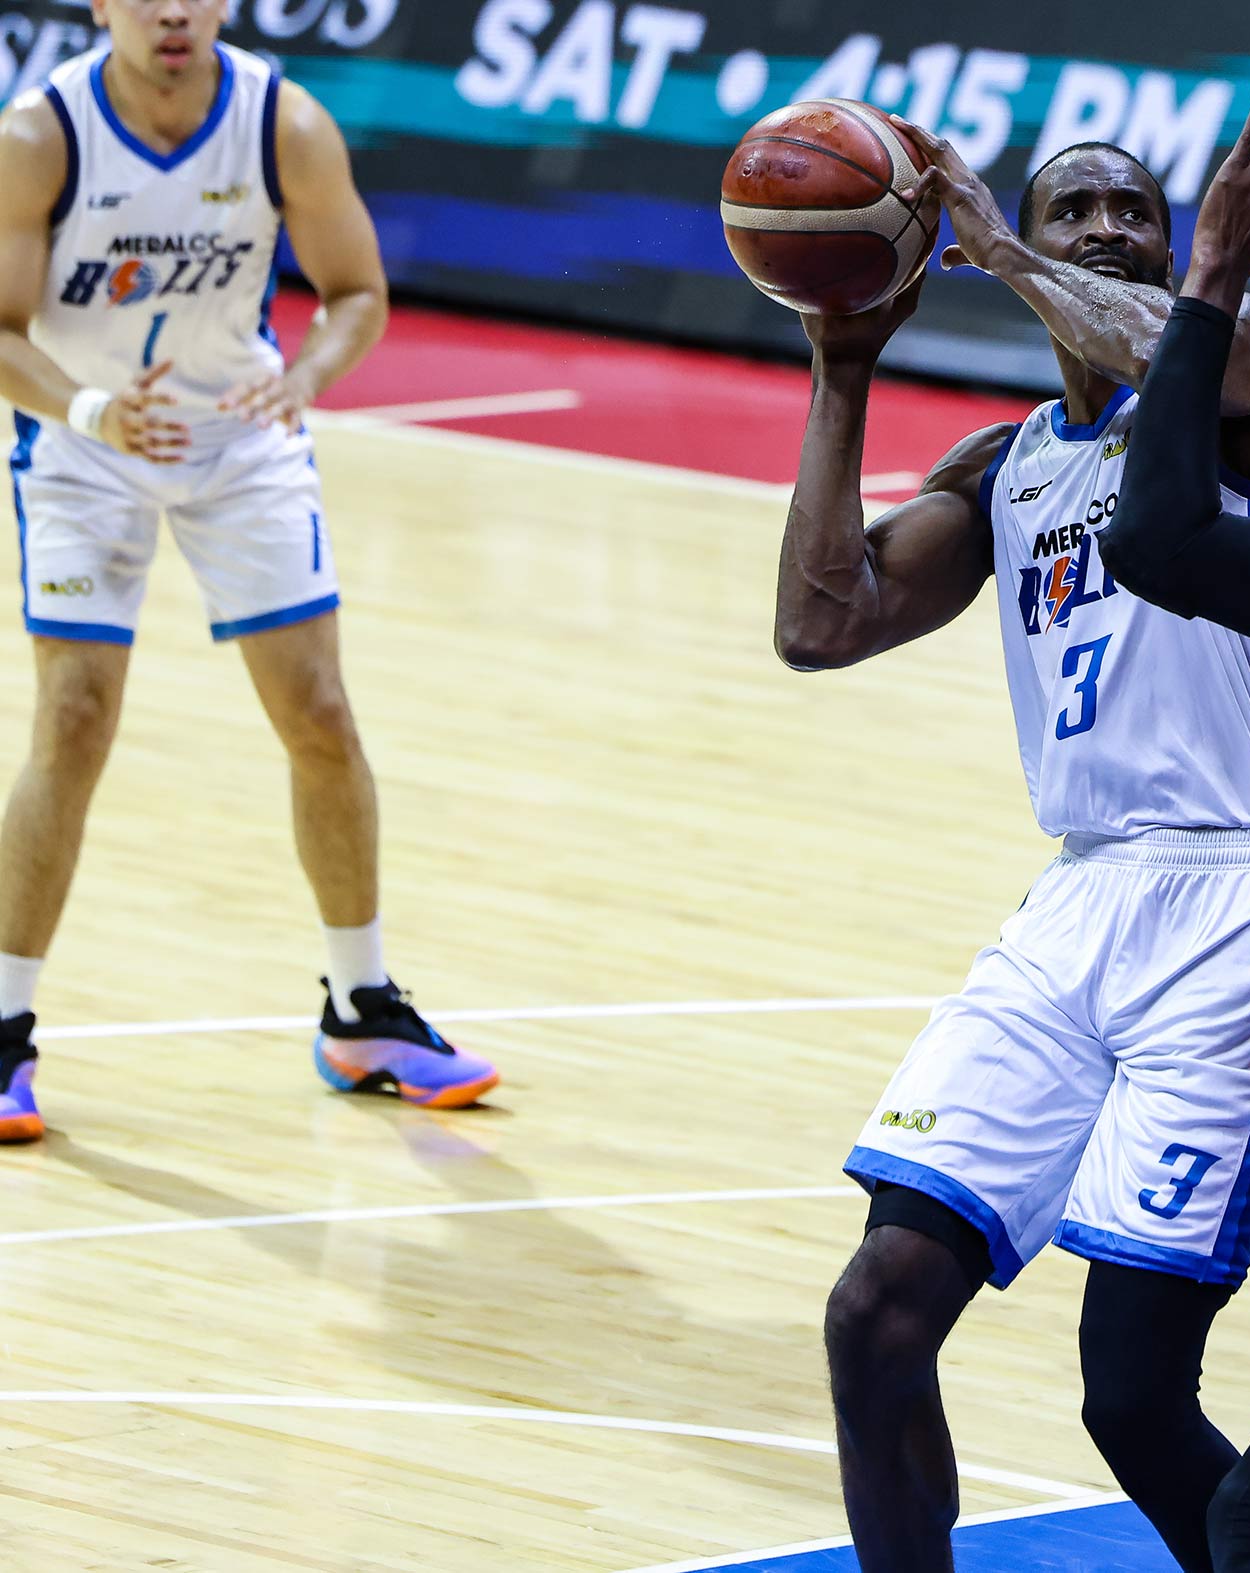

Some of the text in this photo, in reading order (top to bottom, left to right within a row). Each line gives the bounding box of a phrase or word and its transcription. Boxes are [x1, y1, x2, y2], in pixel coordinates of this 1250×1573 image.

[454, 0, 708, 129] SAT
[1026, 60, 1234, 203] PM
[142, 311, 168, 368] 1
[1055, 633, 1114, 741] 3
[1137, 1142, 1222, 1220] 3
